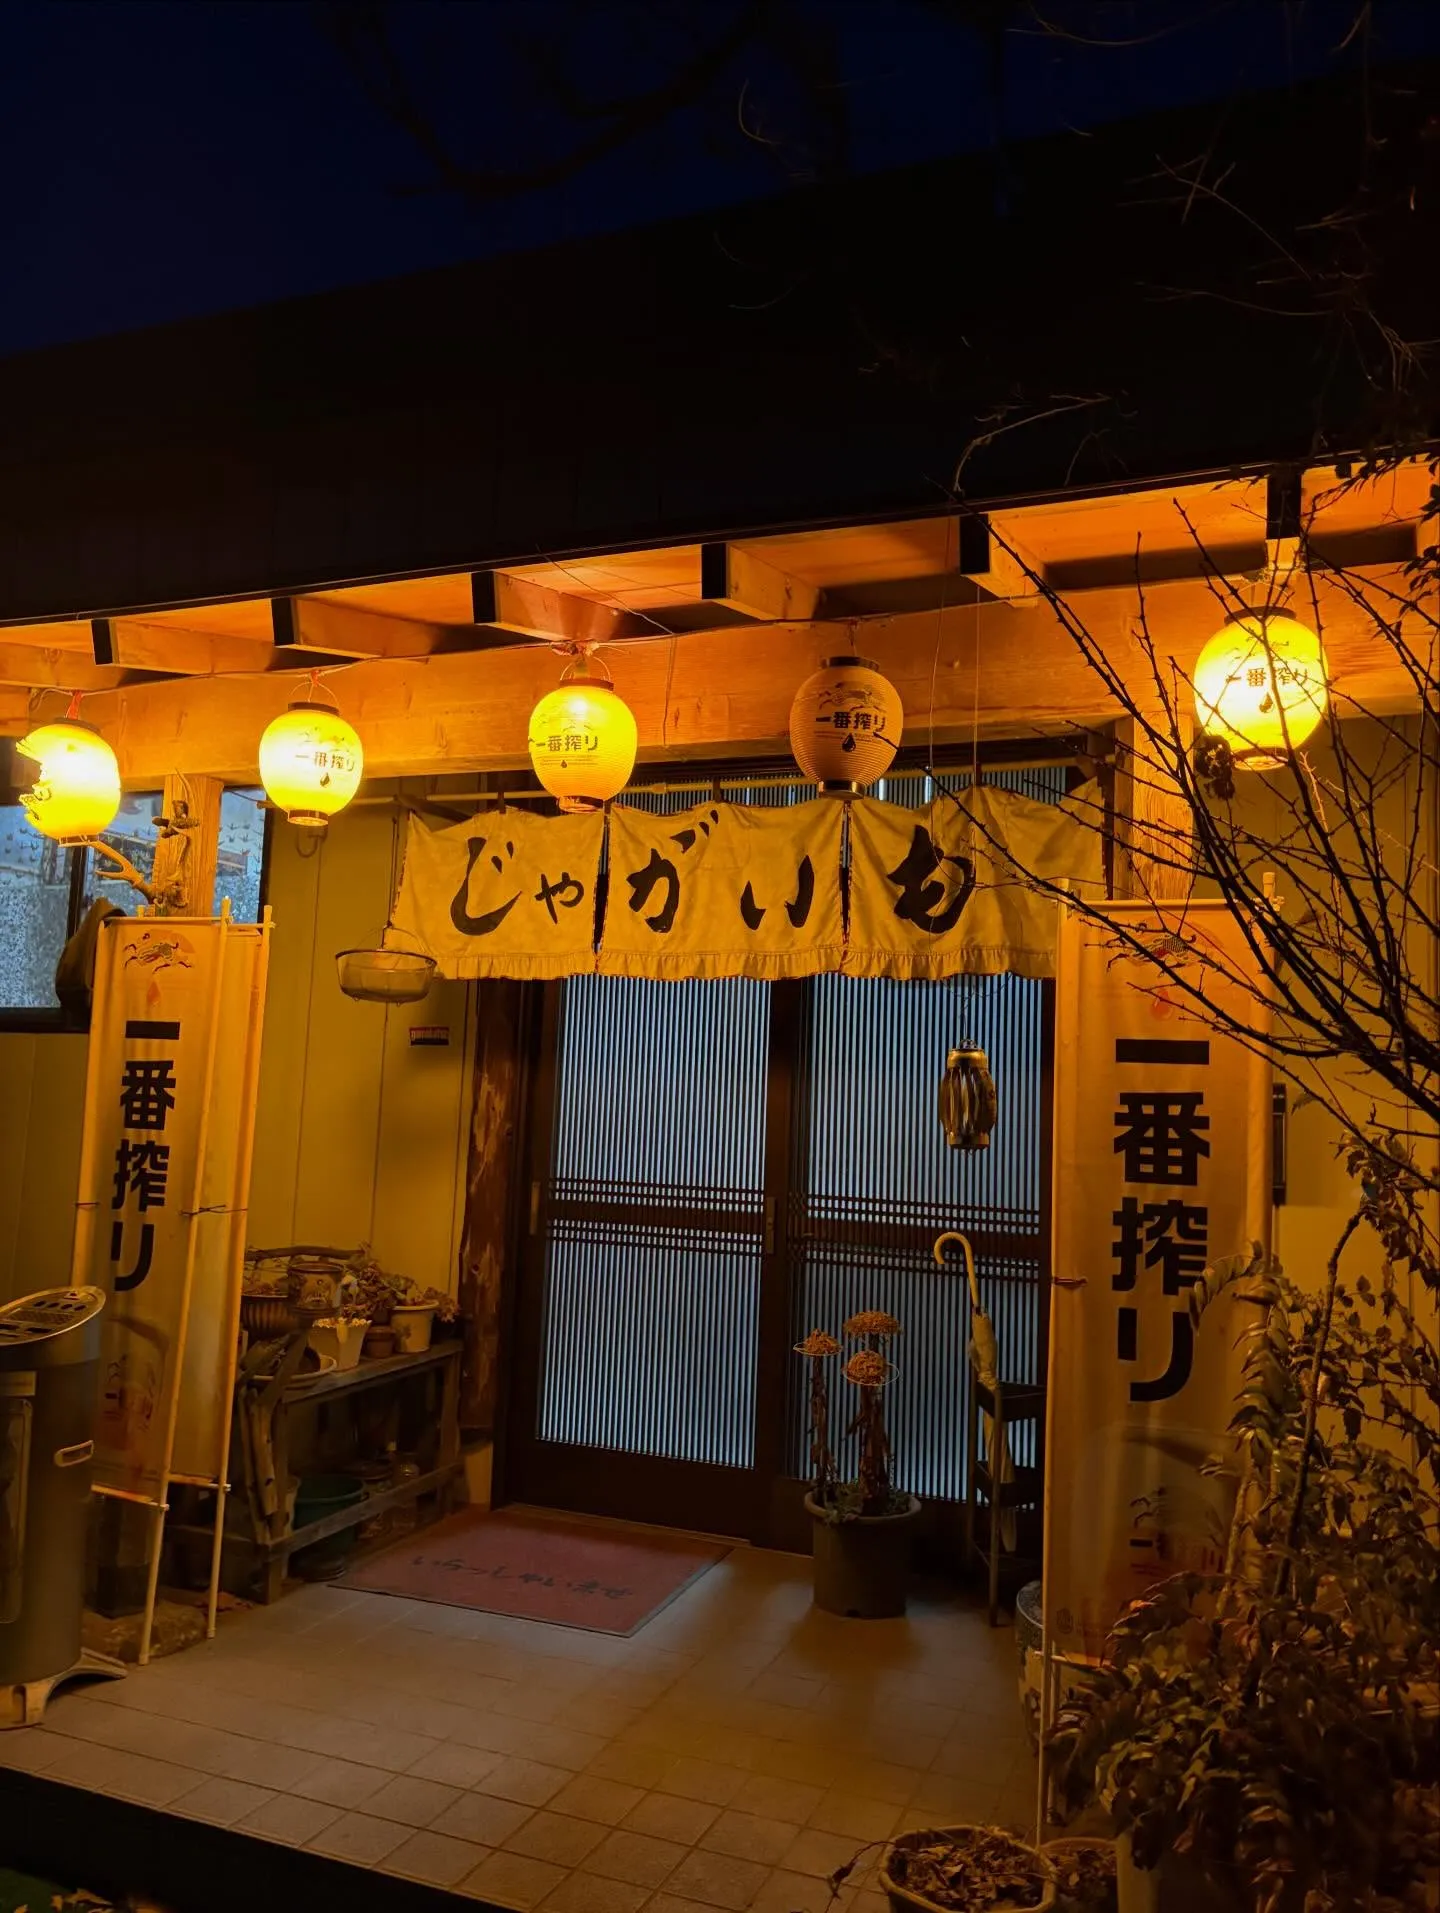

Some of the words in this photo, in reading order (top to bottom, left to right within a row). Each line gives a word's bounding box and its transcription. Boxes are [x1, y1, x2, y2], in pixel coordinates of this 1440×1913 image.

[536, 734, 599, 752] 一番搾り
[815, 711, 887, 733] 一番搾り
[295, 751, 355, 772] 一番搾り
[450, 809, 977, 936] じゃがいも
[111, 1020, 181, 1292] 一番搾り
[1112, 1038, 1211, 1403] 一番搾り
